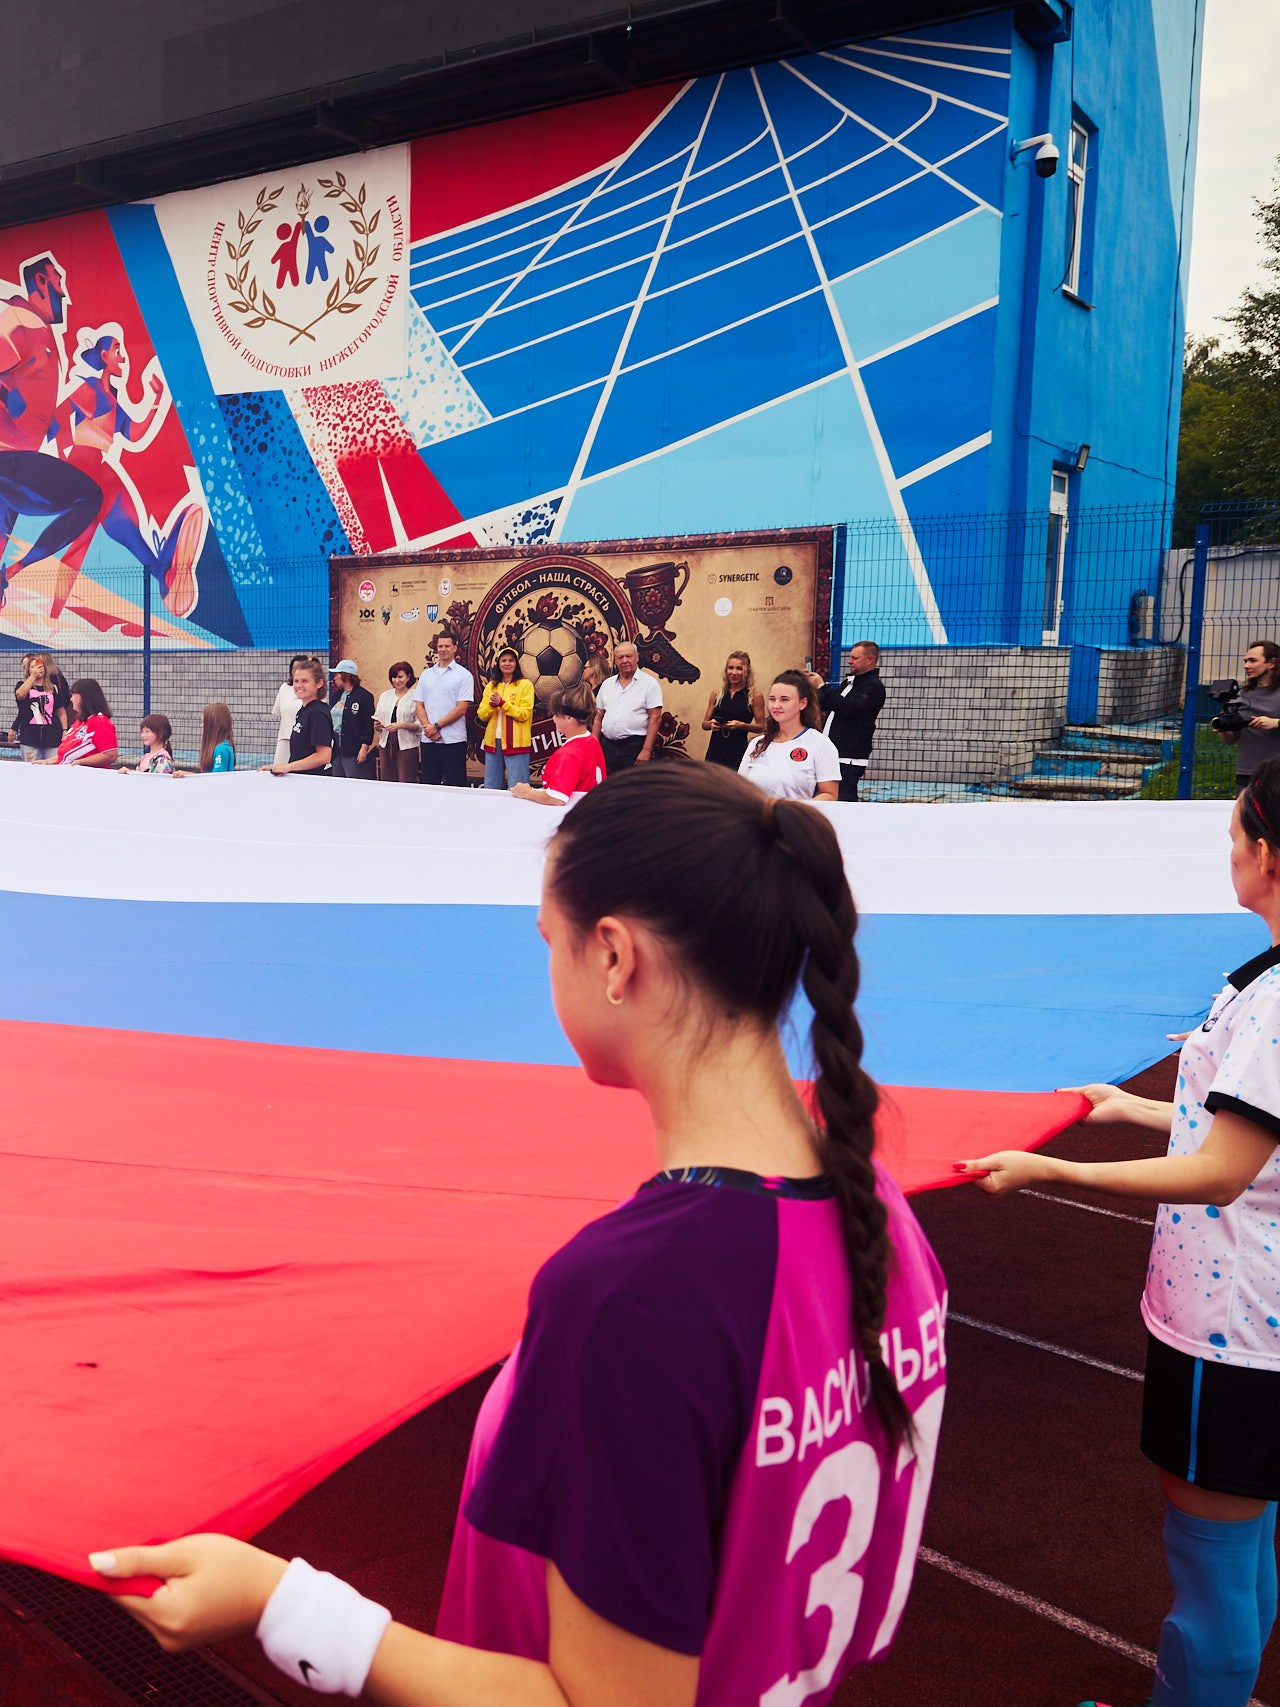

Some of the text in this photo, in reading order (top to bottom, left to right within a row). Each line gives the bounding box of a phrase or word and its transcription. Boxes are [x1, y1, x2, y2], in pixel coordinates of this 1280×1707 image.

[207, 194, 404, 378] ЦЕНТР СПОРТИВНОЙ ПОДГОТОВКИ НИЖЕГОРОДСКОЙ ОБЛАСТИ
[495, 579, 532, 614] ФУТБОЛ
[539, 572, 571, 583] НАША
[573, 577, 610, 612] СТРАСТЬ
[719, 573, 760, 583] SYNERGETIC
